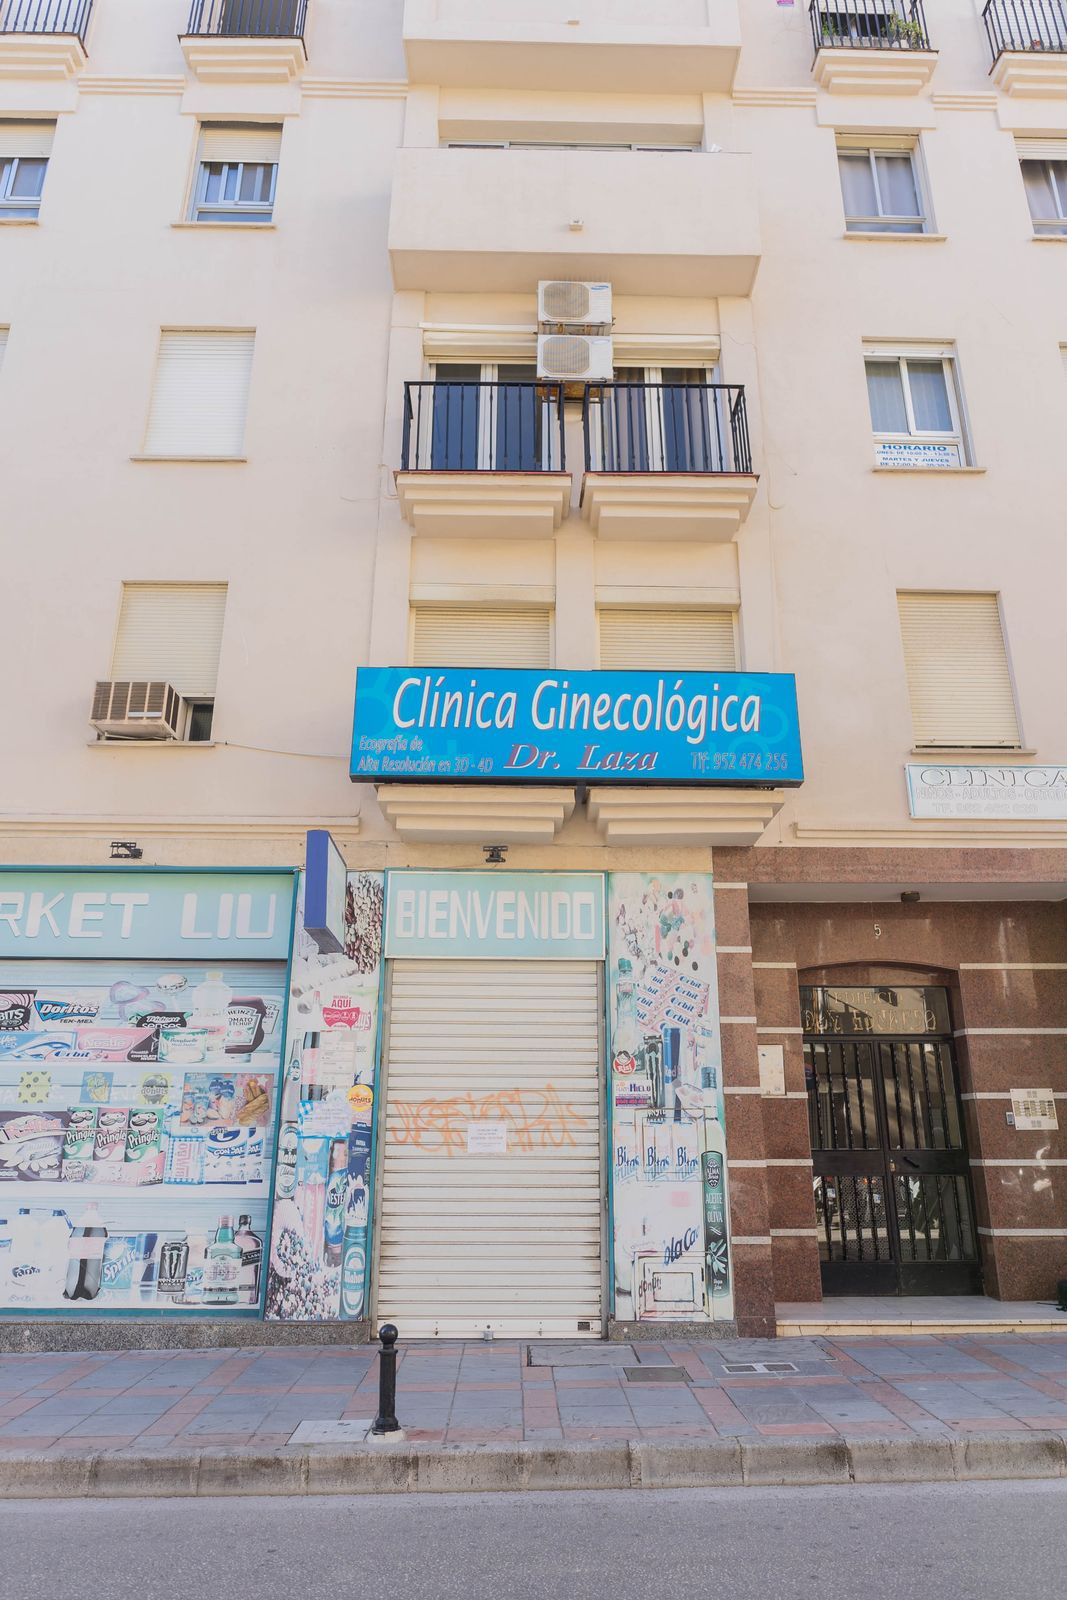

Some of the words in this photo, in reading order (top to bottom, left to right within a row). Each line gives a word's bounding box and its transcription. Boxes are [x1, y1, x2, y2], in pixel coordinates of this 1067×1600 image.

[392, 676, 518, 729] Clínica
[531, 679, 762, 745] Ginecológica
[359, 735, 406, 754] Ecografía
[410, 735, 424, 751] de
[357, 756, 380, 772] Alta
[381, 755, 435, 773] Resolución
[438, 759, 452, 773] en
[477, 758, 494, 773] 4D
[503, 743, 561, 770] Dr.
[576, 744, 659, 771] Laza
[713, 753, 735, 769] 952
[739, 753, 762, 770] 474
[766, 753, 789, 770] 256
[920, 768, 1067, 787] CLINICA
[180, 893, 277, 940] LIU
[395, 889, 596, 940] BIENVENIDO
[873, 923, 882, 937] 5
[679, 975, 702, 989] Orbit
[675, 985, 699, 1000] Orbit
[40, 1003, 100, 1014] Doritos
[331, 997, 352, 1009] AQUÍ
[670, 997, 695, 1012] Orbit
[665, 1009, 691, 1026] Orbit
[54, 1050, 91, 1058] Orbit
[706, 1211, 723, 1223] OLIVA
[11, 1265, 41, 1278] Fanta
[103, 1248, 137, 1282] Sprite
